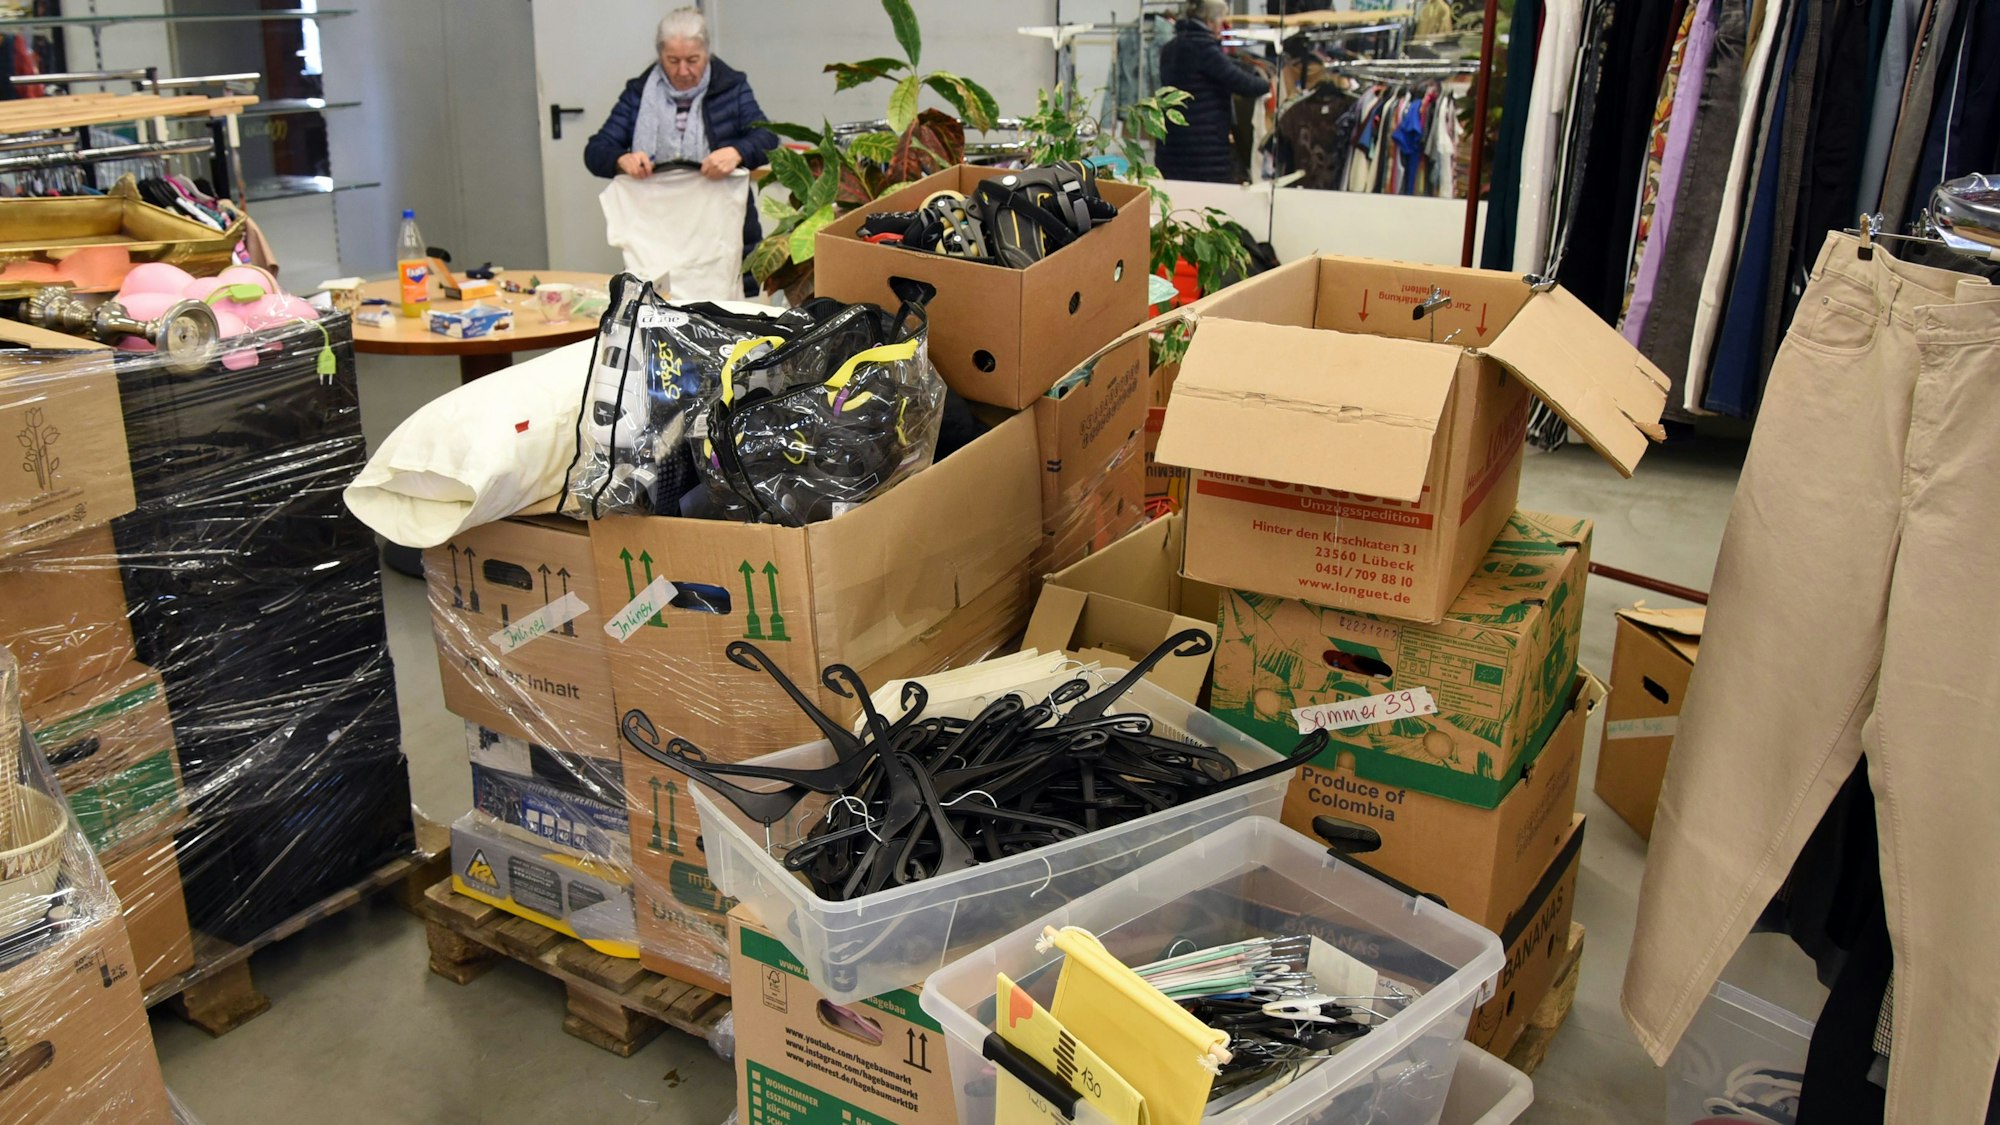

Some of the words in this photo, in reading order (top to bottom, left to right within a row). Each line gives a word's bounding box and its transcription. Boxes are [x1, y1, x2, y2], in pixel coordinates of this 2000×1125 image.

[658, 340, 681, 401] STREET
[1301, 497, 1420, 526] Umzugsspedition
[1252, 519, 1293, 537] Hinter
[1296, 527, 1319, 541] den
[1323, 531, 1399, 554] Kirschkaten
[1403, 543, 1417, 556] 31
[1315, 546, 1356, 563] 23560
[1362, 552, 1415, 572] Lübeck
[1315, 562, 1342, 576] 0451
[1355, 569, 1377, 582] 709
[1381, 573, 1396, 585] 88
[1400, 576, 1413, 588] 10
[1298, 576, 1411, 604] www.longuet.de
[528, 674, 580, 700] Inhalt
[1301, 704, 1377, 733] Sommer
[1301, 766, 1380, 799] Produce
[1385, 788, 1406, 804] of
[1308, 787, 1396, 822] Colombia
[1284, 916, 1381, 960] BANANAS
[1503, 894, 1564, 990] BANANAS
[112, 970, 129, 983] min
[785, 1026, 912, 1086] www.youtube.com/hagebaumarkt
[785, 1038, 919, 1101] www.instagram.com/hagebaumarkt
[765, 1076, 819, 1107] WOHNZIMMER
[786, 1050, 919, 1113] www.pinterest.de/hagebaumarktDE
[1080, 1066, 1102, 1099] 130
[766, 1090, 808, 1116] ESSZIMMER
[766, 1102, 791, 1121] KÜCHE
